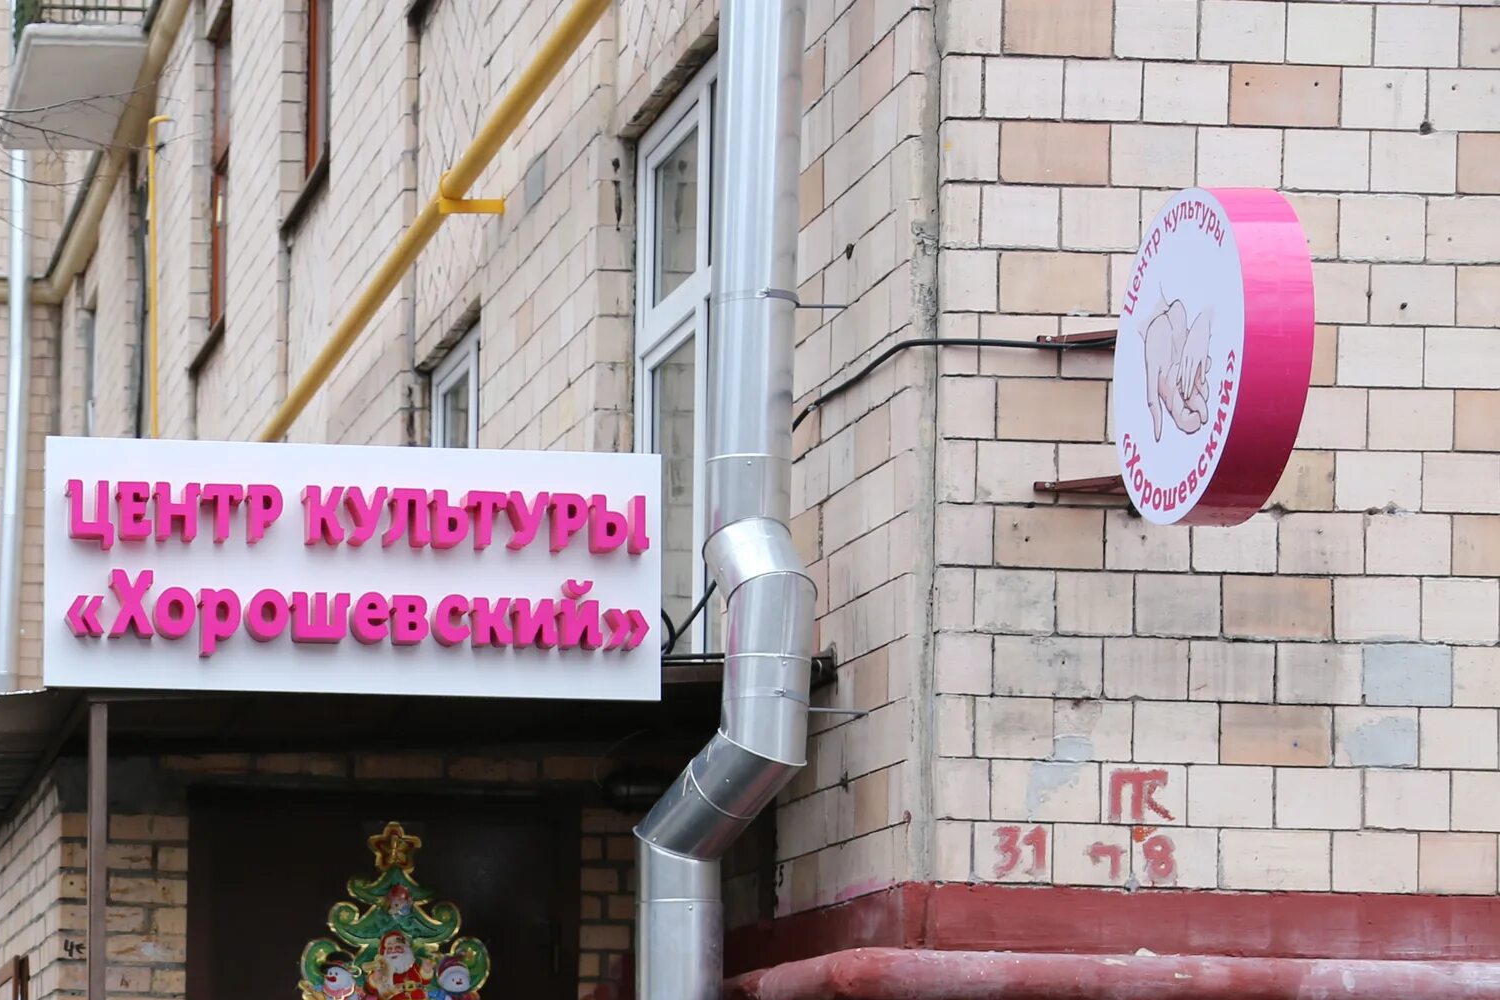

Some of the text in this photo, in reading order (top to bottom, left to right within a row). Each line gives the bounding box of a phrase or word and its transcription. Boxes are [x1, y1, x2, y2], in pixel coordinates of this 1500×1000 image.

[1123, 198, 1226, 316] Центр культуры
[1122, 349, 1236, 513] «Хорошевский»
[64, 477, 651, 555] ЦЕНТР КУЛЬТУРЫ
[63, 567, 651, 658] «Хорошевский»
